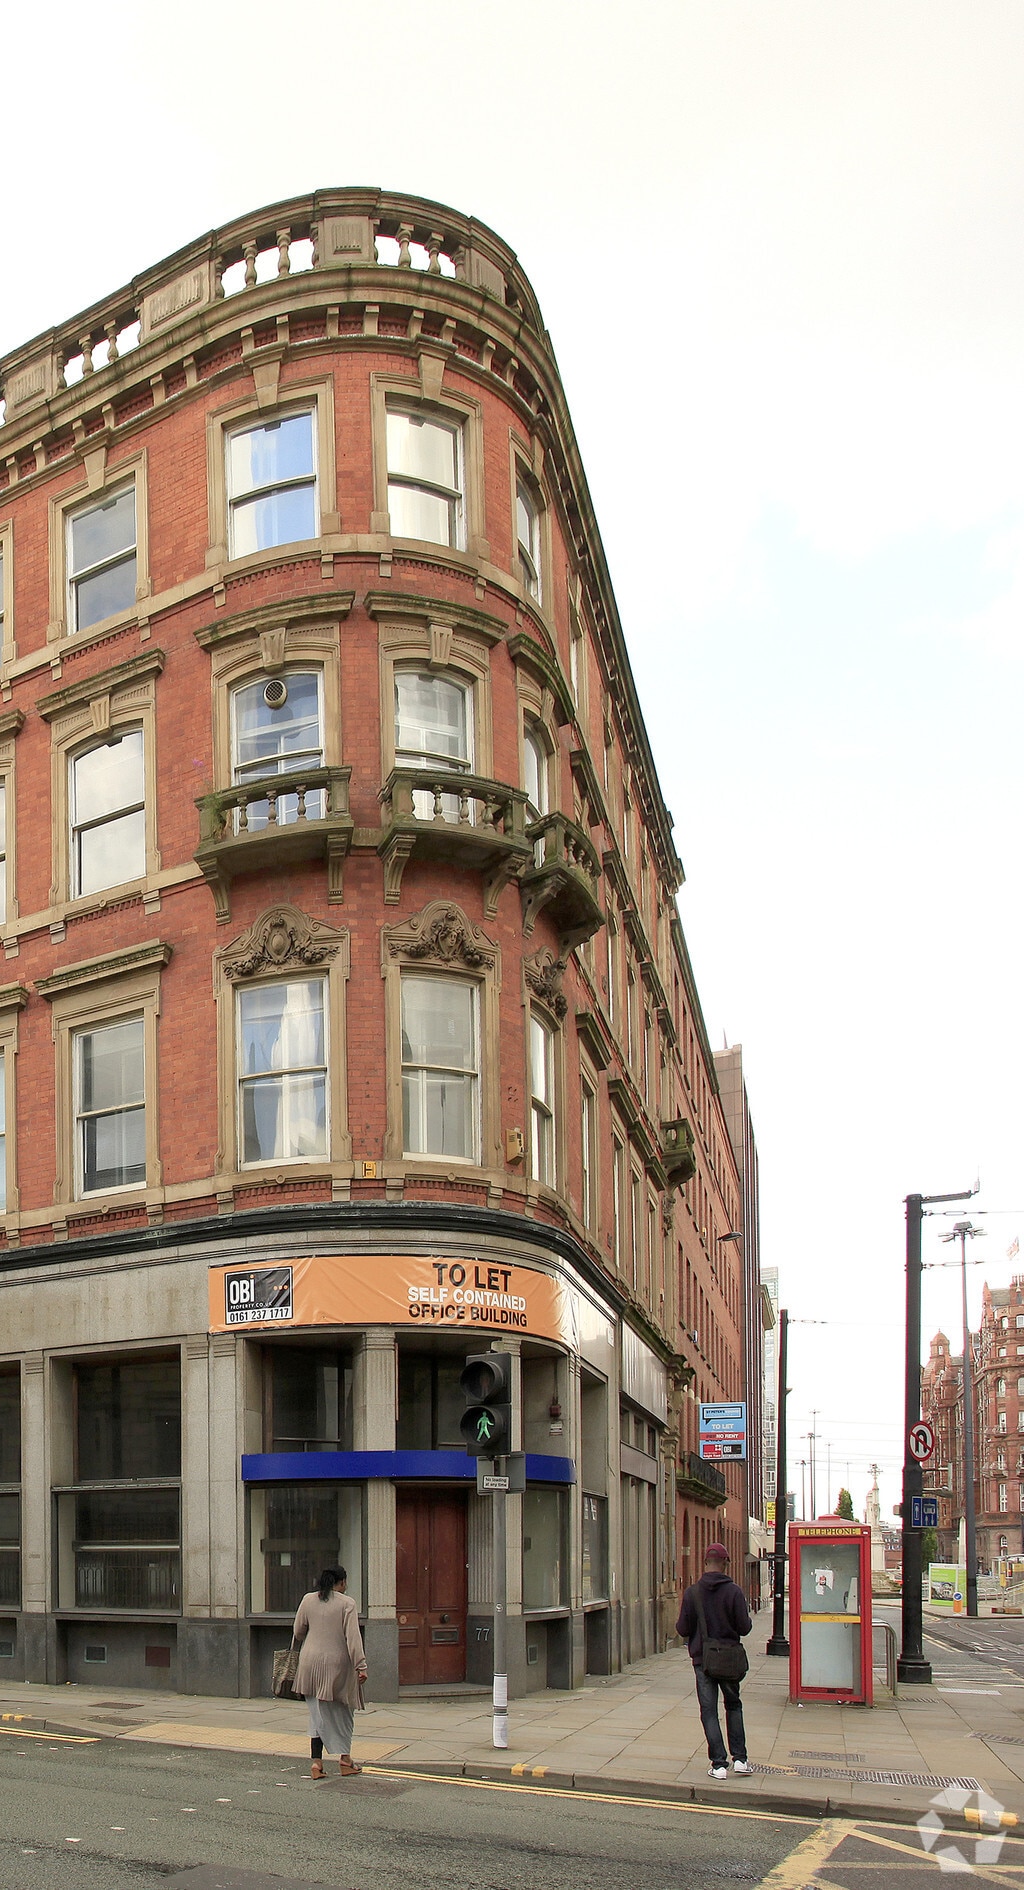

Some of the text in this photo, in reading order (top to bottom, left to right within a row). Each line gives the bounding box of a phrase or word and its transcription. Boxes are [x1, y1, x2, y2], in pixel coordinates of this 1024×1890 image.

[433, 1263, 511, 1292] TO LET
[408, 1287, 526, 1311] SELF CONTAINED
[230, 1308, 289, 1322] 0161 237 1717
[409, 1304, 527, 1326] OFFICE BUILDING
[804, 1528, 856, 1536] TELEPHONE
[476, 1627, 490, 1641] 77
